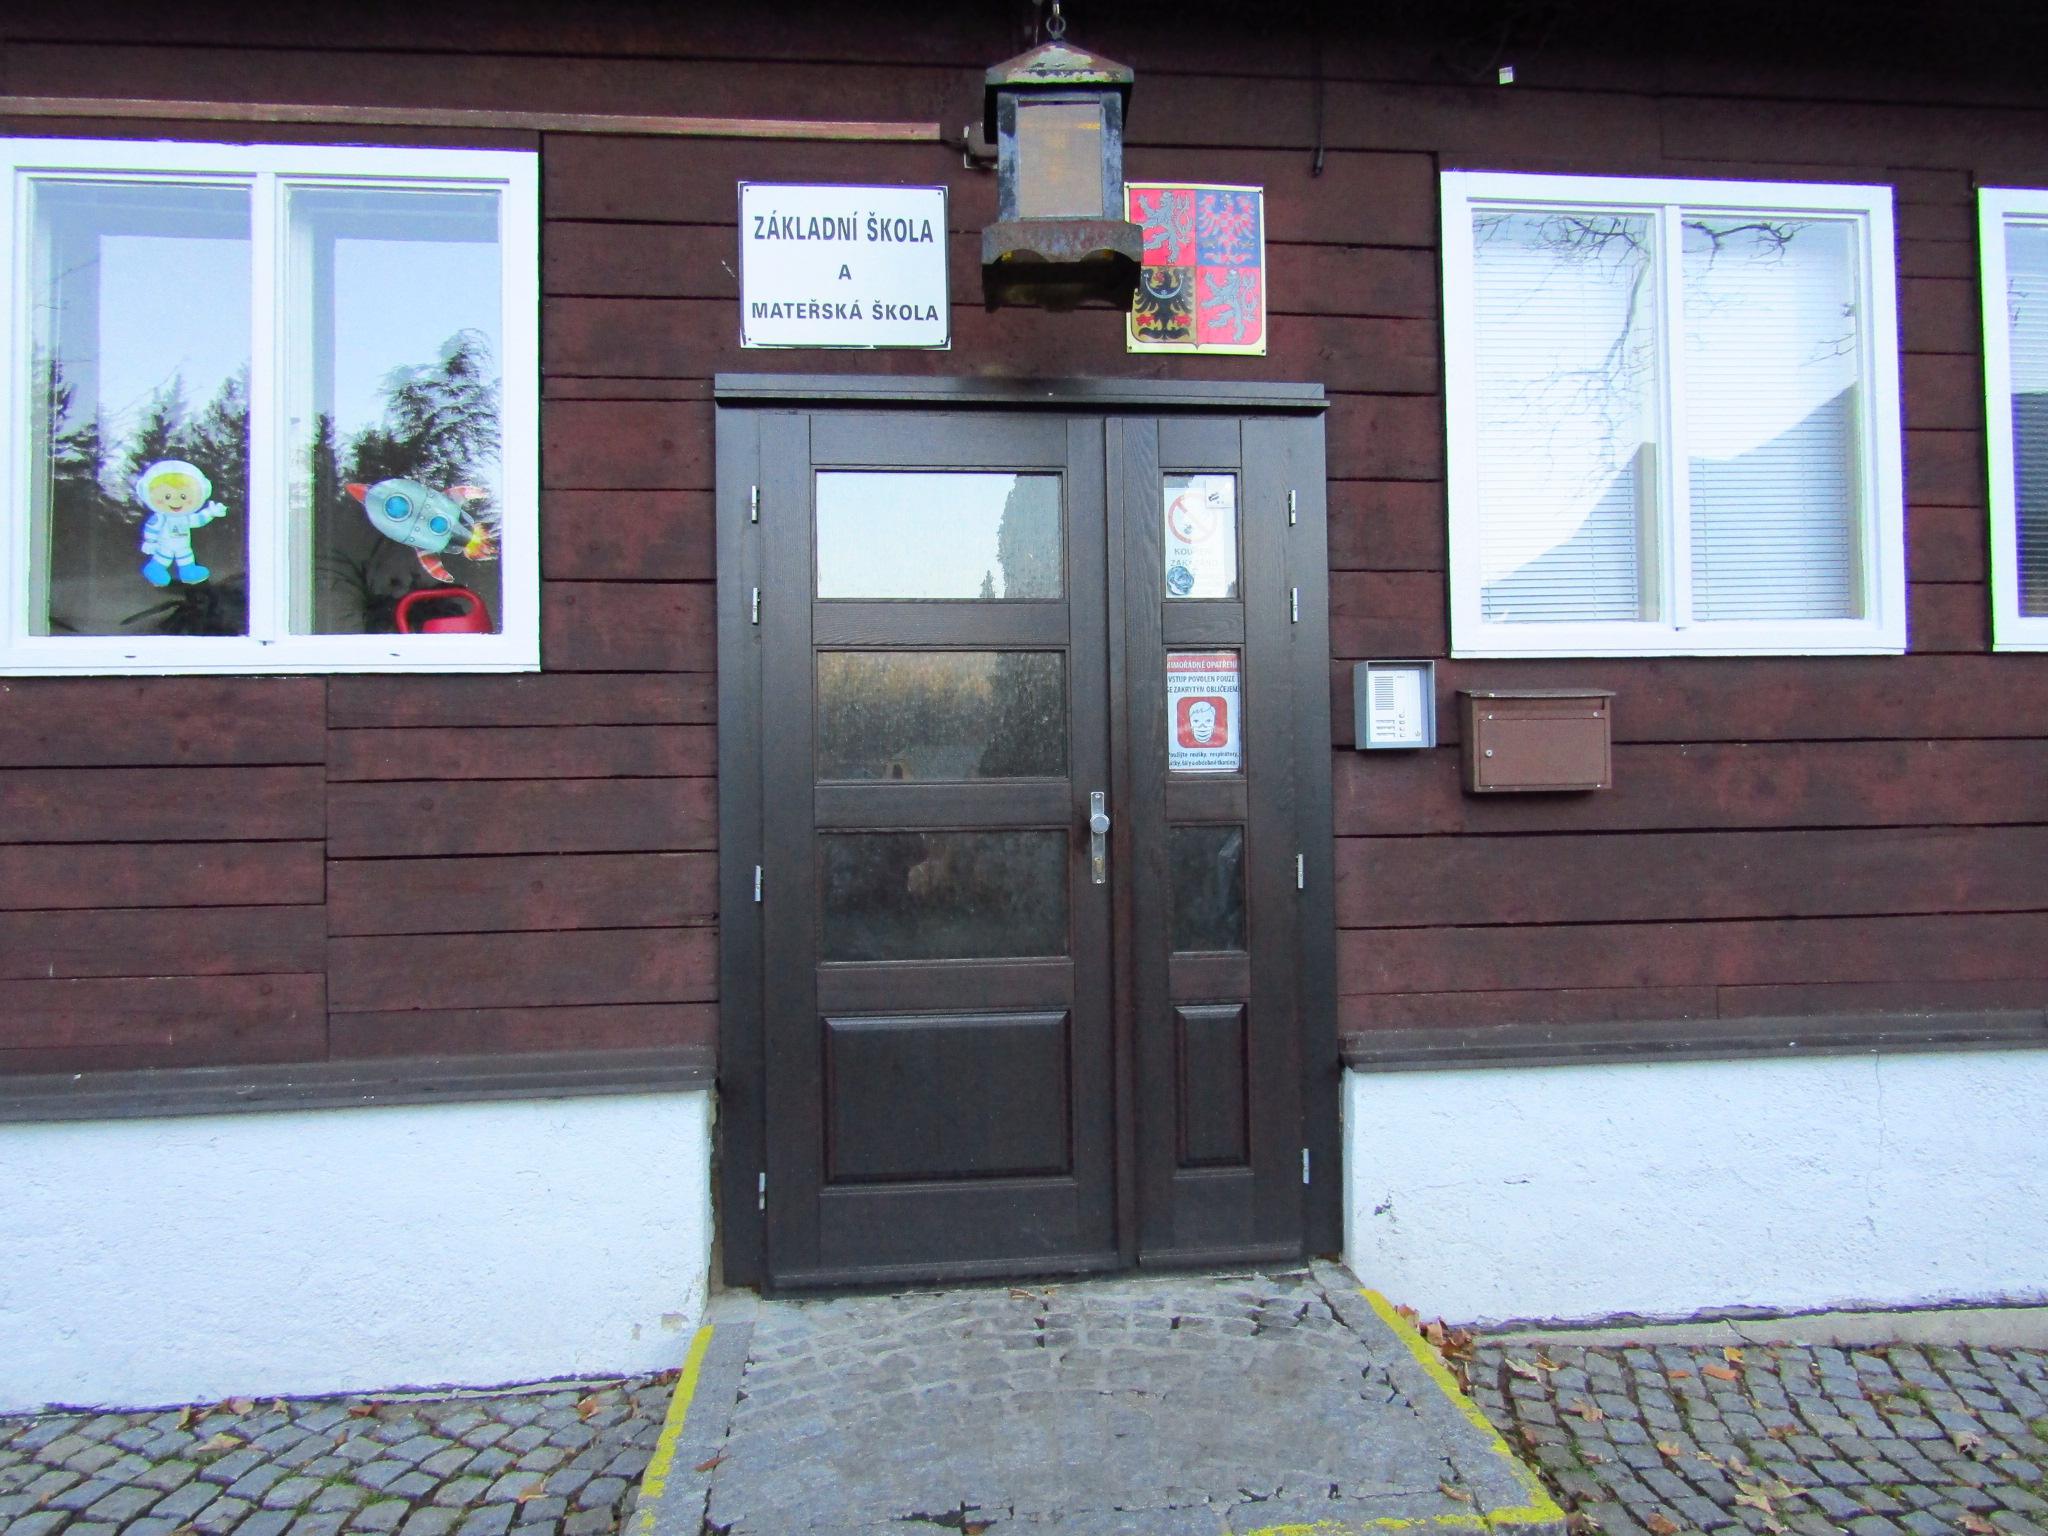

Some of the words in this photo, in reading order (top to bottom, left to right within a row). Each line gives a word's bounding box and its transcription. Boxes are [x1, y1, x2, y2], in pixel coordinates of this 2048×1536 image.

[754, 210, 858, 241] ZÁKLADNÍ
[867, 211, 934, 243] ŠKOLA
[838, 264, 852, 280] A
[752, 299, 863, 320] MATEŘSKÁ
[872, 299, 939, 321] ŠKOLA
